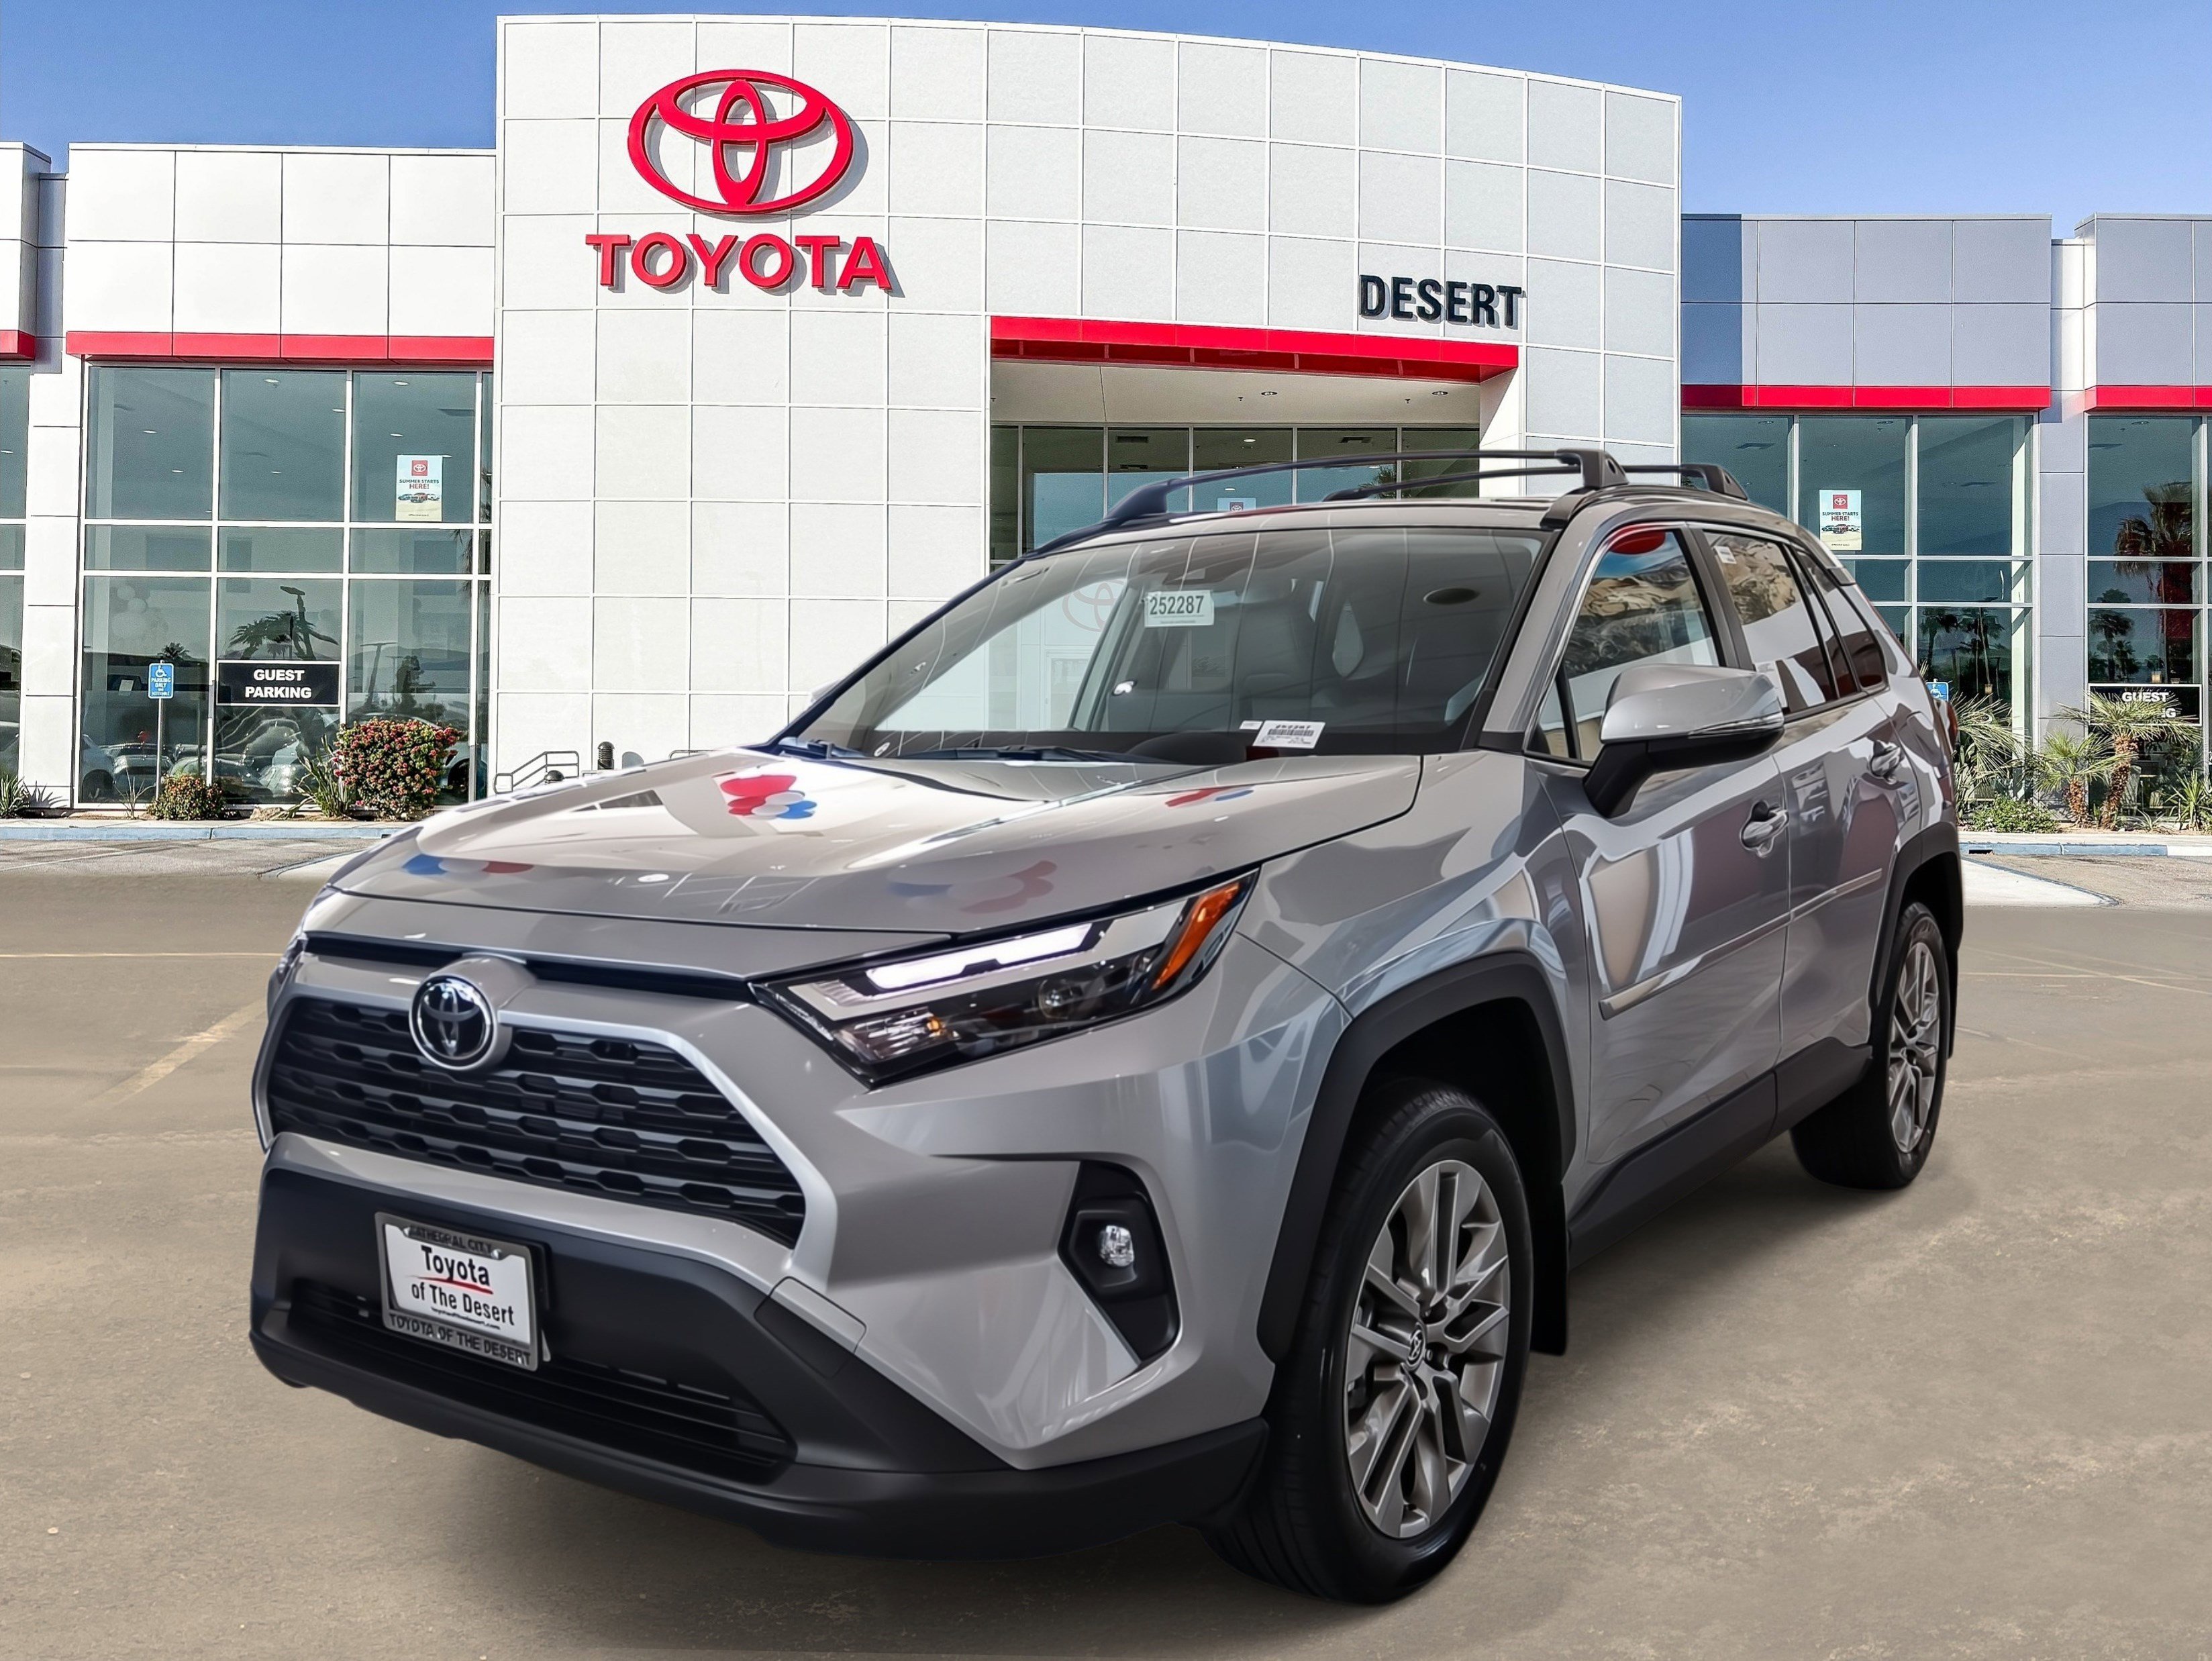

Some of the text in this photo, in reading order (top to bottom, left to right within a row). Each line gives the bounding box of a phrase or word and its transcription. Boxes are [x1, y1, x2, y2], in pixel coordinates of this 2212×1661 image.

[586, 232, 892, 291] TOYOTA
[1359, 274, 1522, 327] DESERT
[1150, 595, 1205, 615] 252287
[245, 686, 312, 699] PARKING
[253, 669, 305, 681] GUEST
[2121, 692, 2169, 703] GUEST
[421, 1245, 490, 1287] Toyota
[411, 1282, 425, 1301] of
[430, 1285, 458, 1309] The
[463, 1293, 515, 1325] Desert
[389, 1313, 434, 1336] TOYOTA
[437, 1328, 453, 1342] OF
[456, 1332, 481, 1351] THE
[484, 1340, 531, 1365] DESERT
